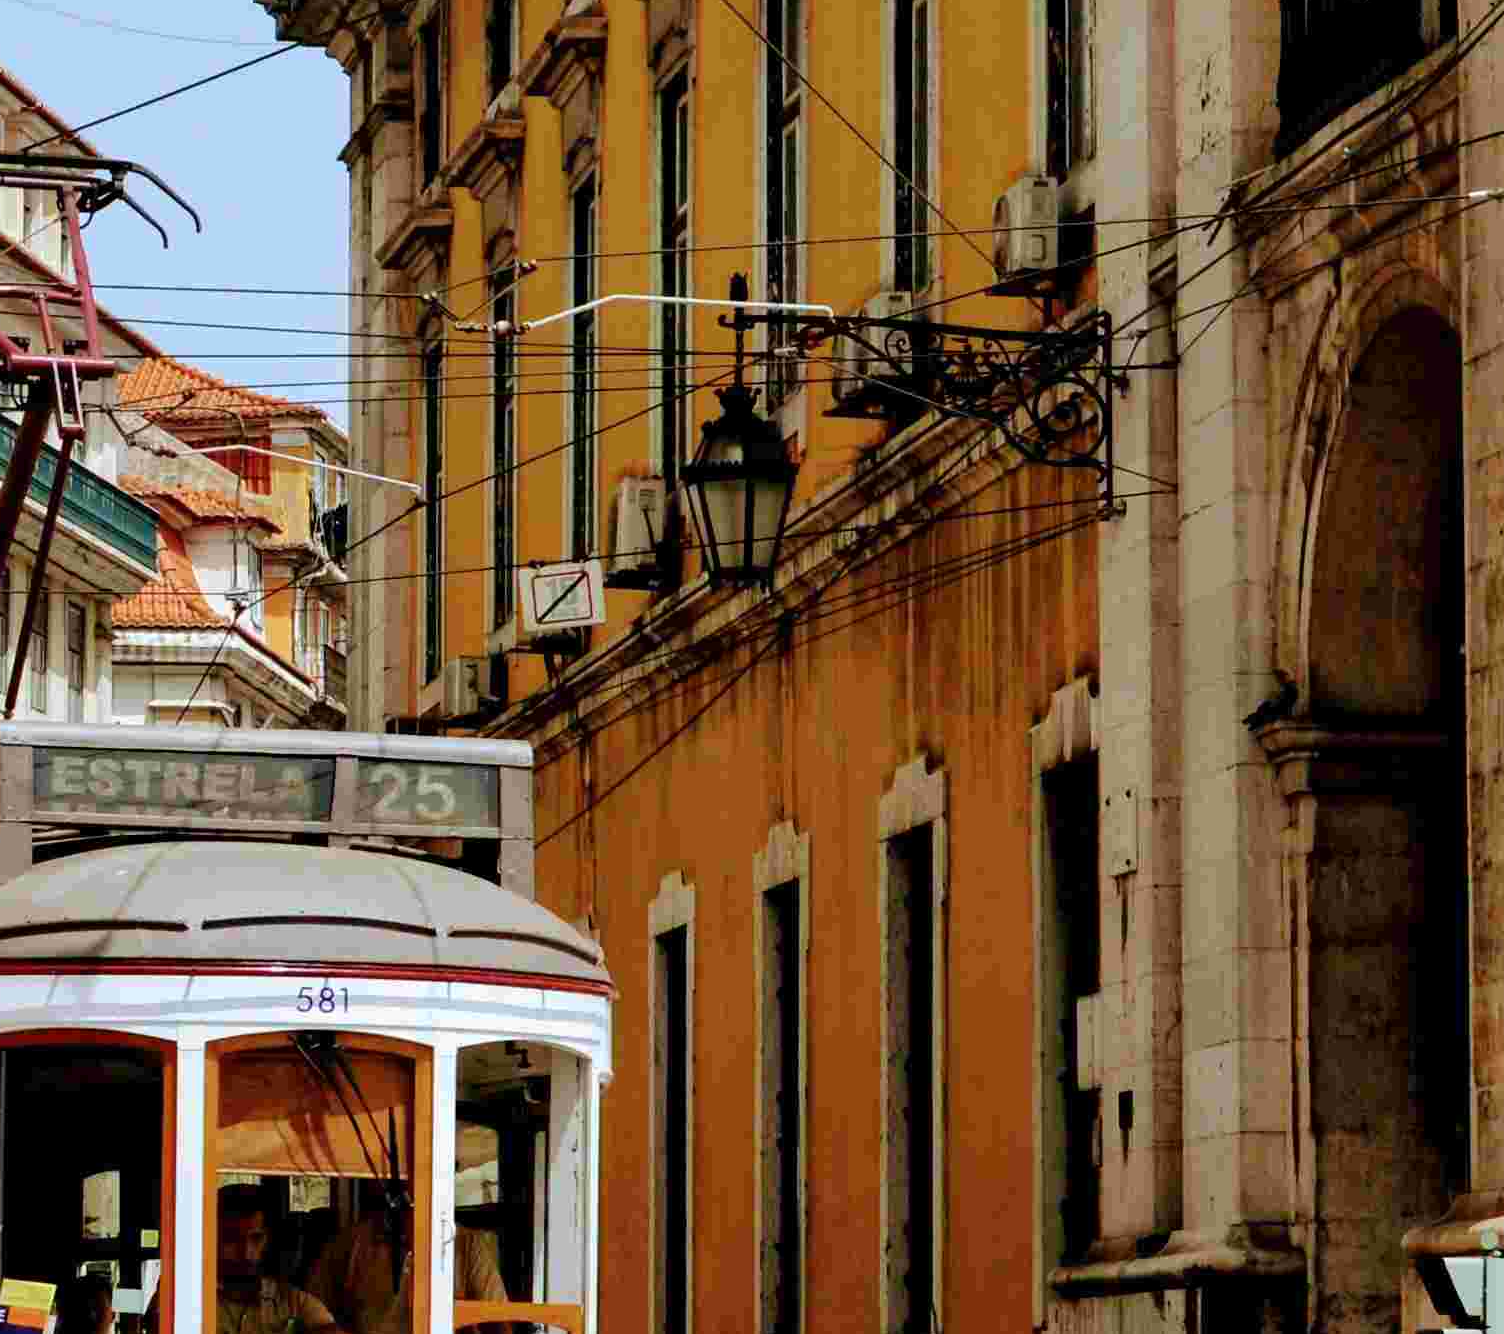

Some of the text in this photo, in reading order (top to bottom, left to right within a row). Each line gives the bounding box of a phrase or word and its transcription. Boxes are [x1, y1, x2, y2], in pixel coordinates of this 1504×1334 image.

[49, 755, 456, 821] ESTRELA 25
[296, 986, 349, 1014] 581
